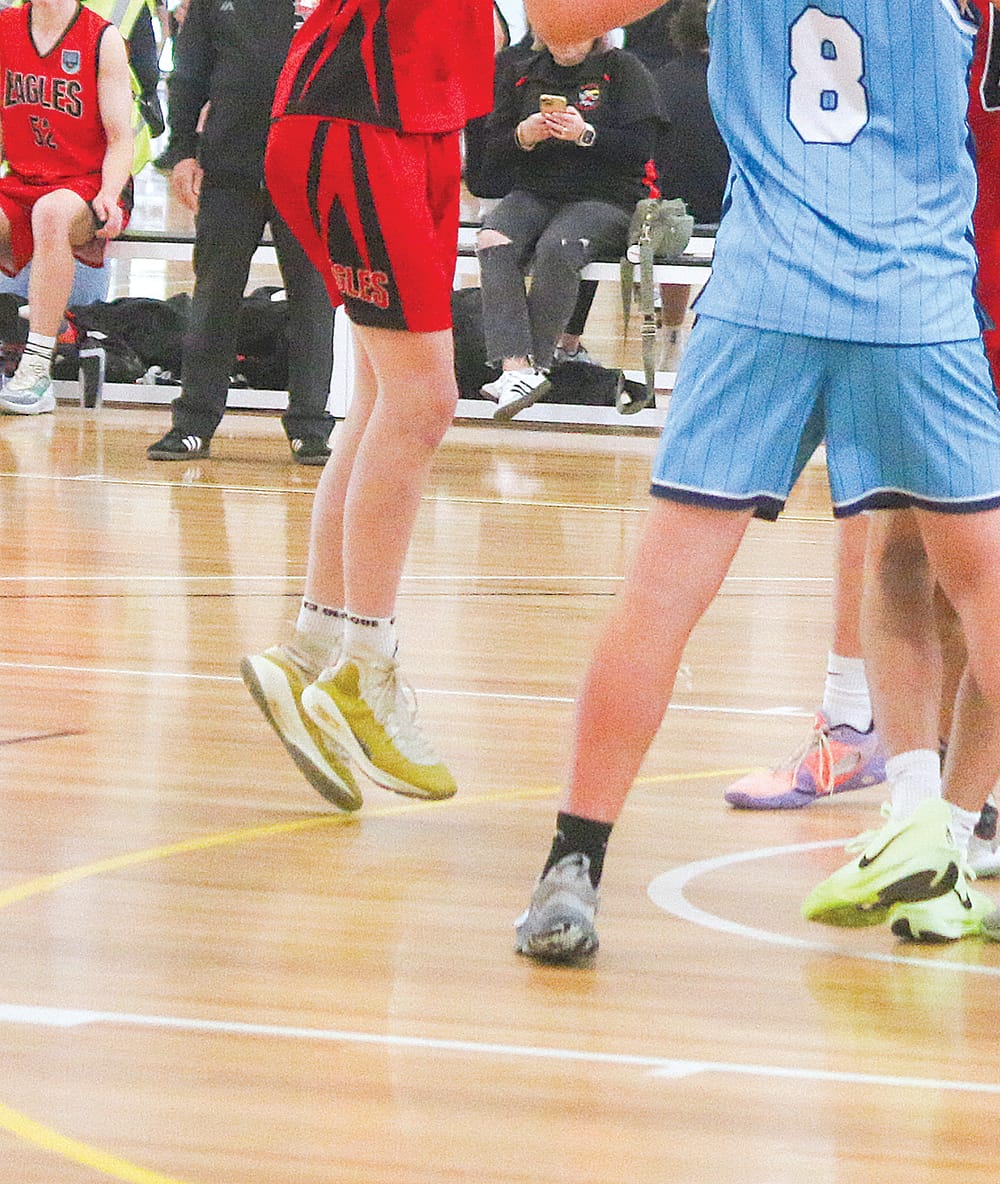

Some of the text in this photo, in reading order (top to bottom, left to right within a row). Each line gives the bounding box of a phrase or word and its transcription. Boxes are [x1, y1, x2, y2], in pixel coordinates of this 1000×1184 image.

[4, 68, 83, 119] EAGLES
[786, 5, 870, 146] 8
[331, 263, 390, 310] GLES
